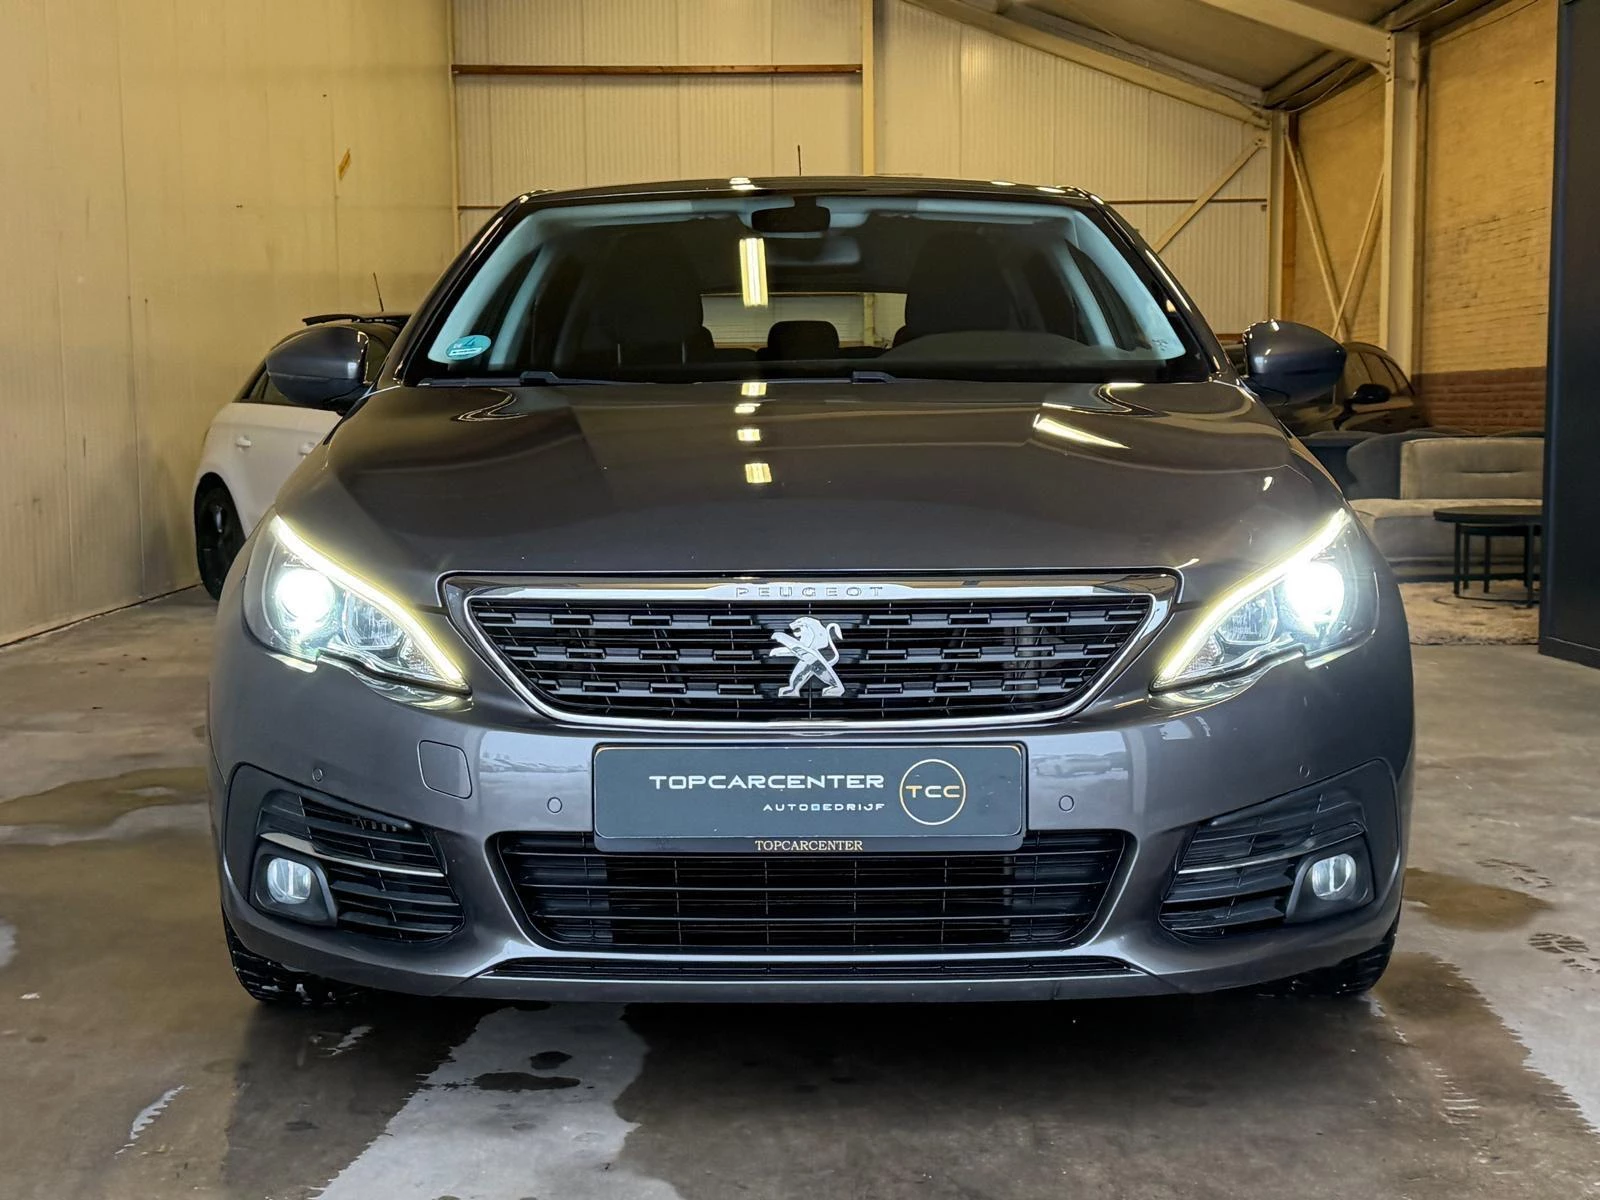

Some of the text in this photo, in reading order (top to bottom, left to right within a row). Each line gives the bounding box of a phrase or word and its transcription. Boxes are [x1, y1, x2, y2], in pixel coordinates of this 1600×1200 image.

[735, 586, 883, 598] PEUGEOT
[648, 775, 885, 790] TOPCARCENTER
[905, 785, 961, 798] TCC
[762, 803, 885, 812] AUTOBEDRIJF
[754, 840, 864, 852] TOPCARCENTER
